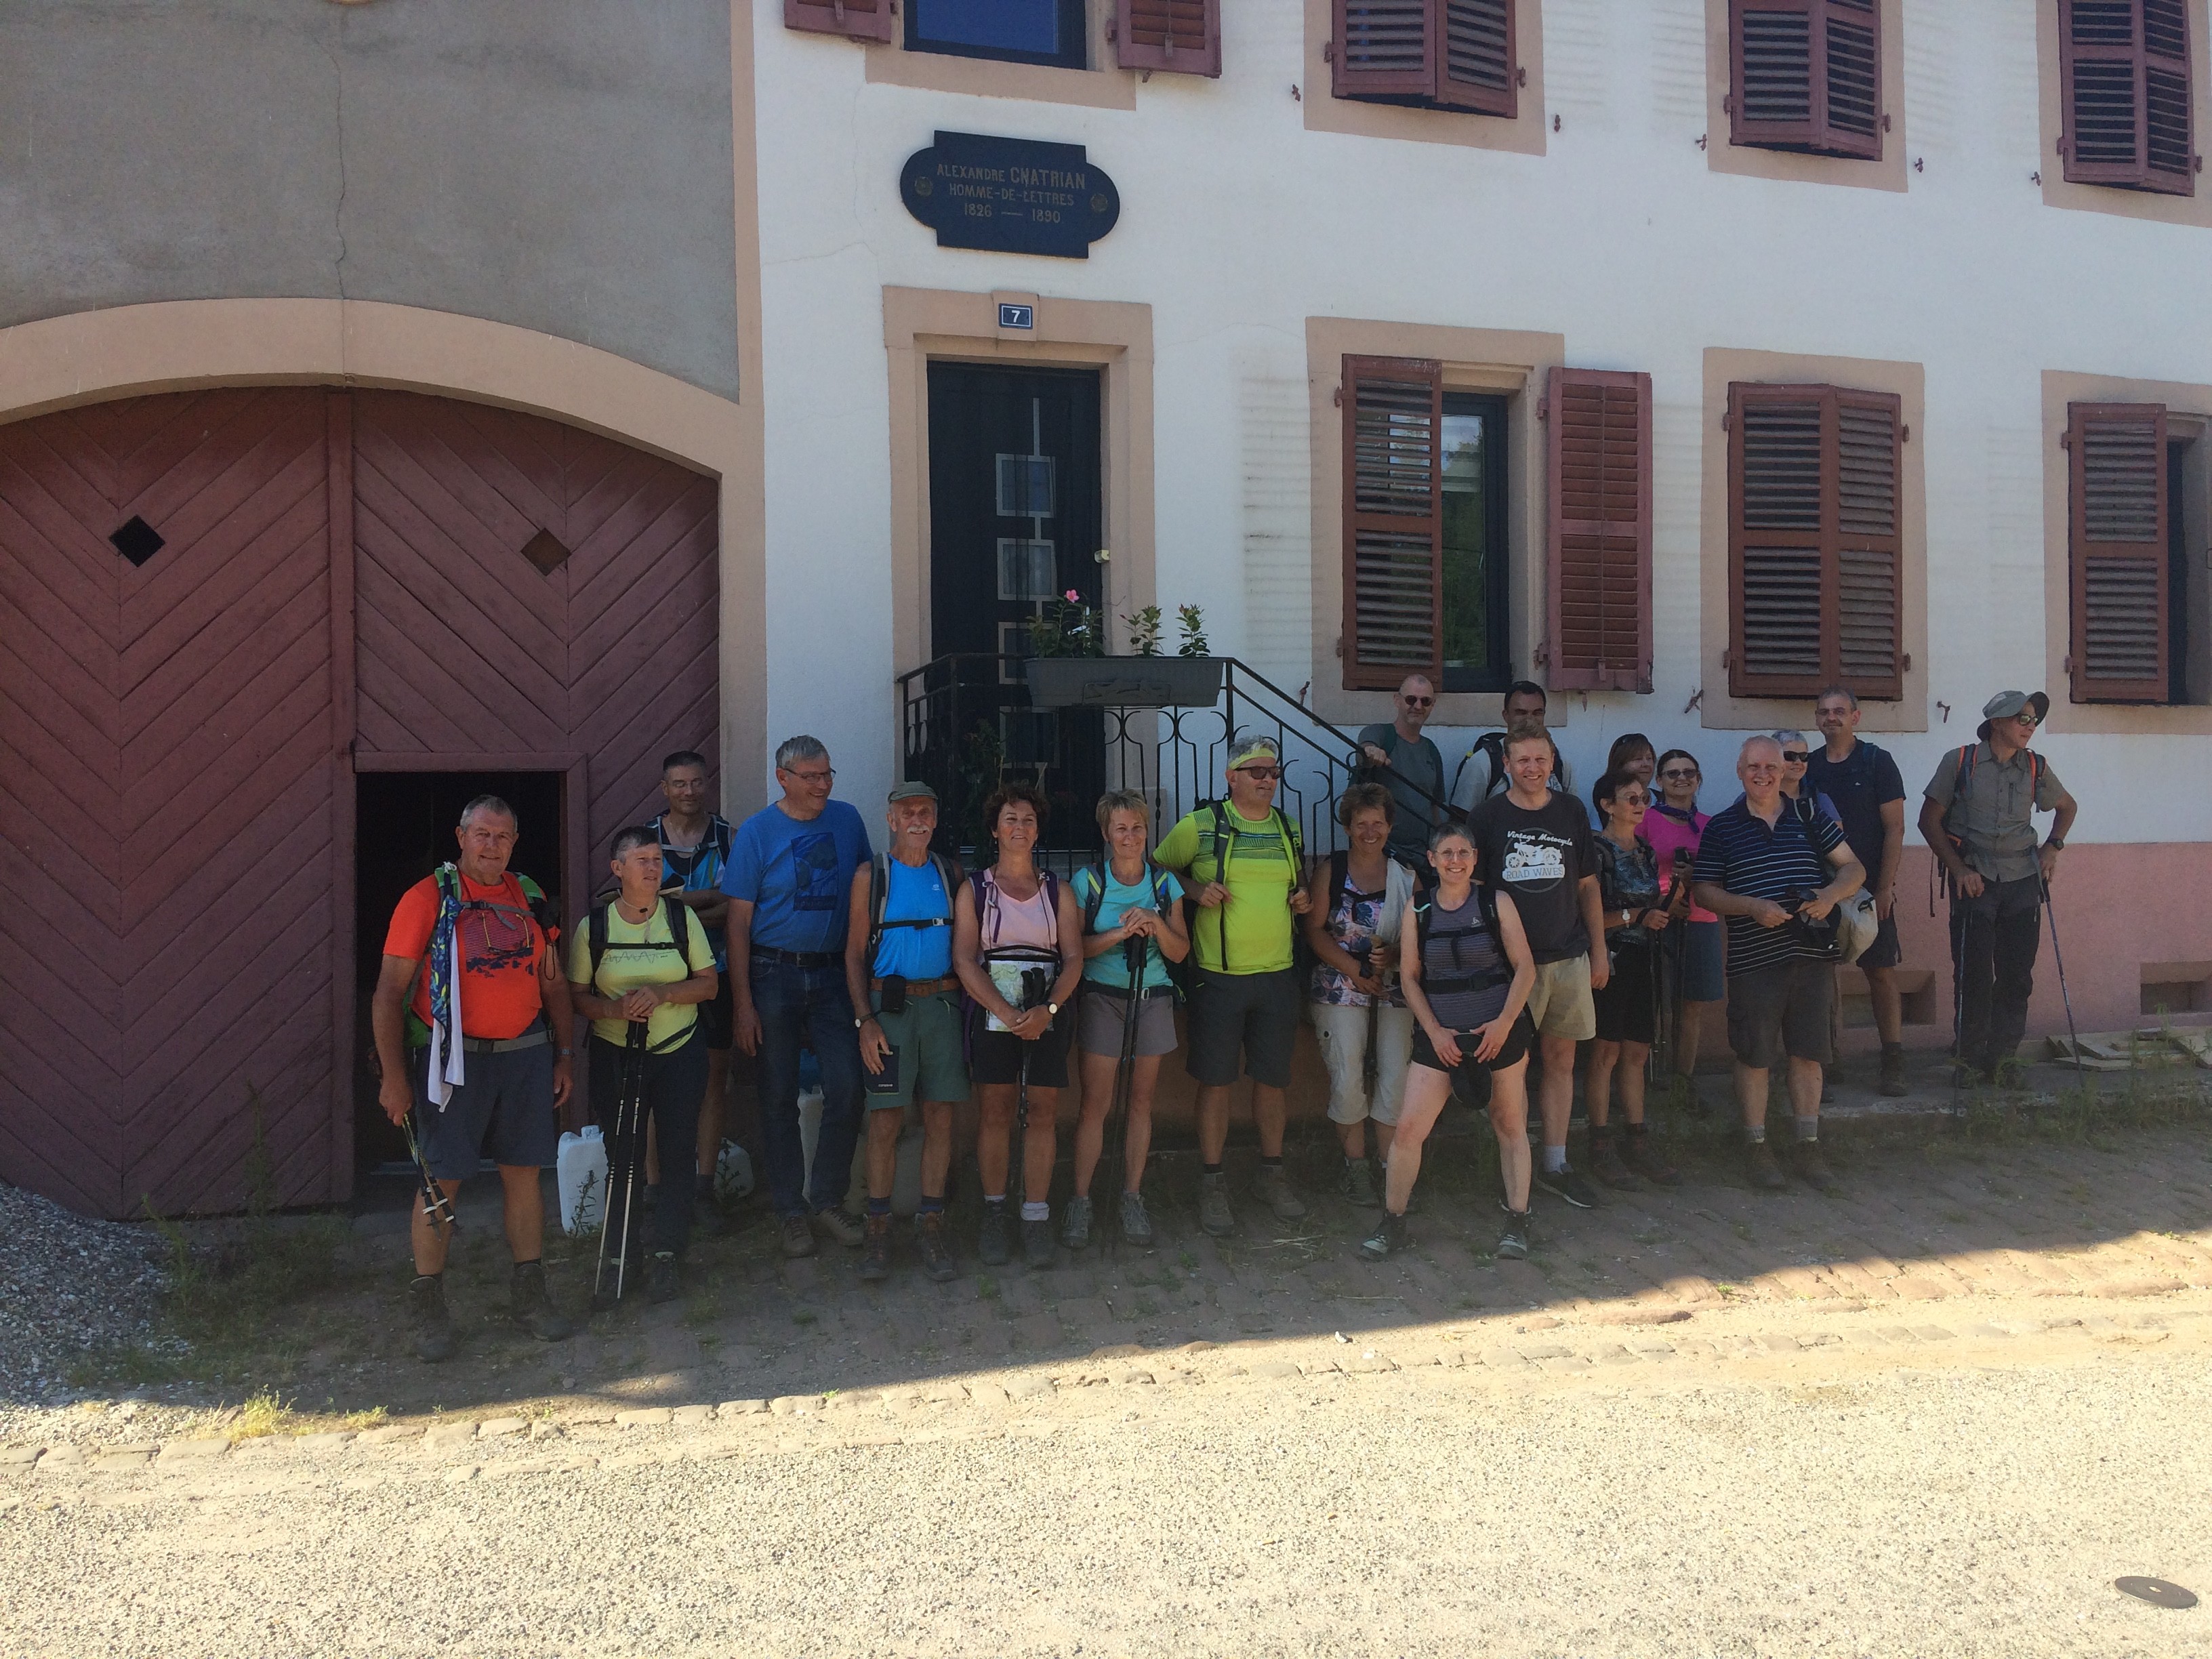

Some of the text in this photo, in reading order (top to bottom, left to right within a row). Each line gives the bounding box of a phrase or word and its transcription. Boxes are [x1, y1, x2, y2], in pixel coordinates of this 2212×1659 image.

[937, 163, 1006, 183] ALEXANDRE
[964, 203, 993, 218] 1826
[1031, 208, 1061, 224] 1890
[1011, 310, 1021, 323] 7
[1507, 830, 1536, 842] Vintage
[1507, 867, 1563, 879] ROAD WAVES
